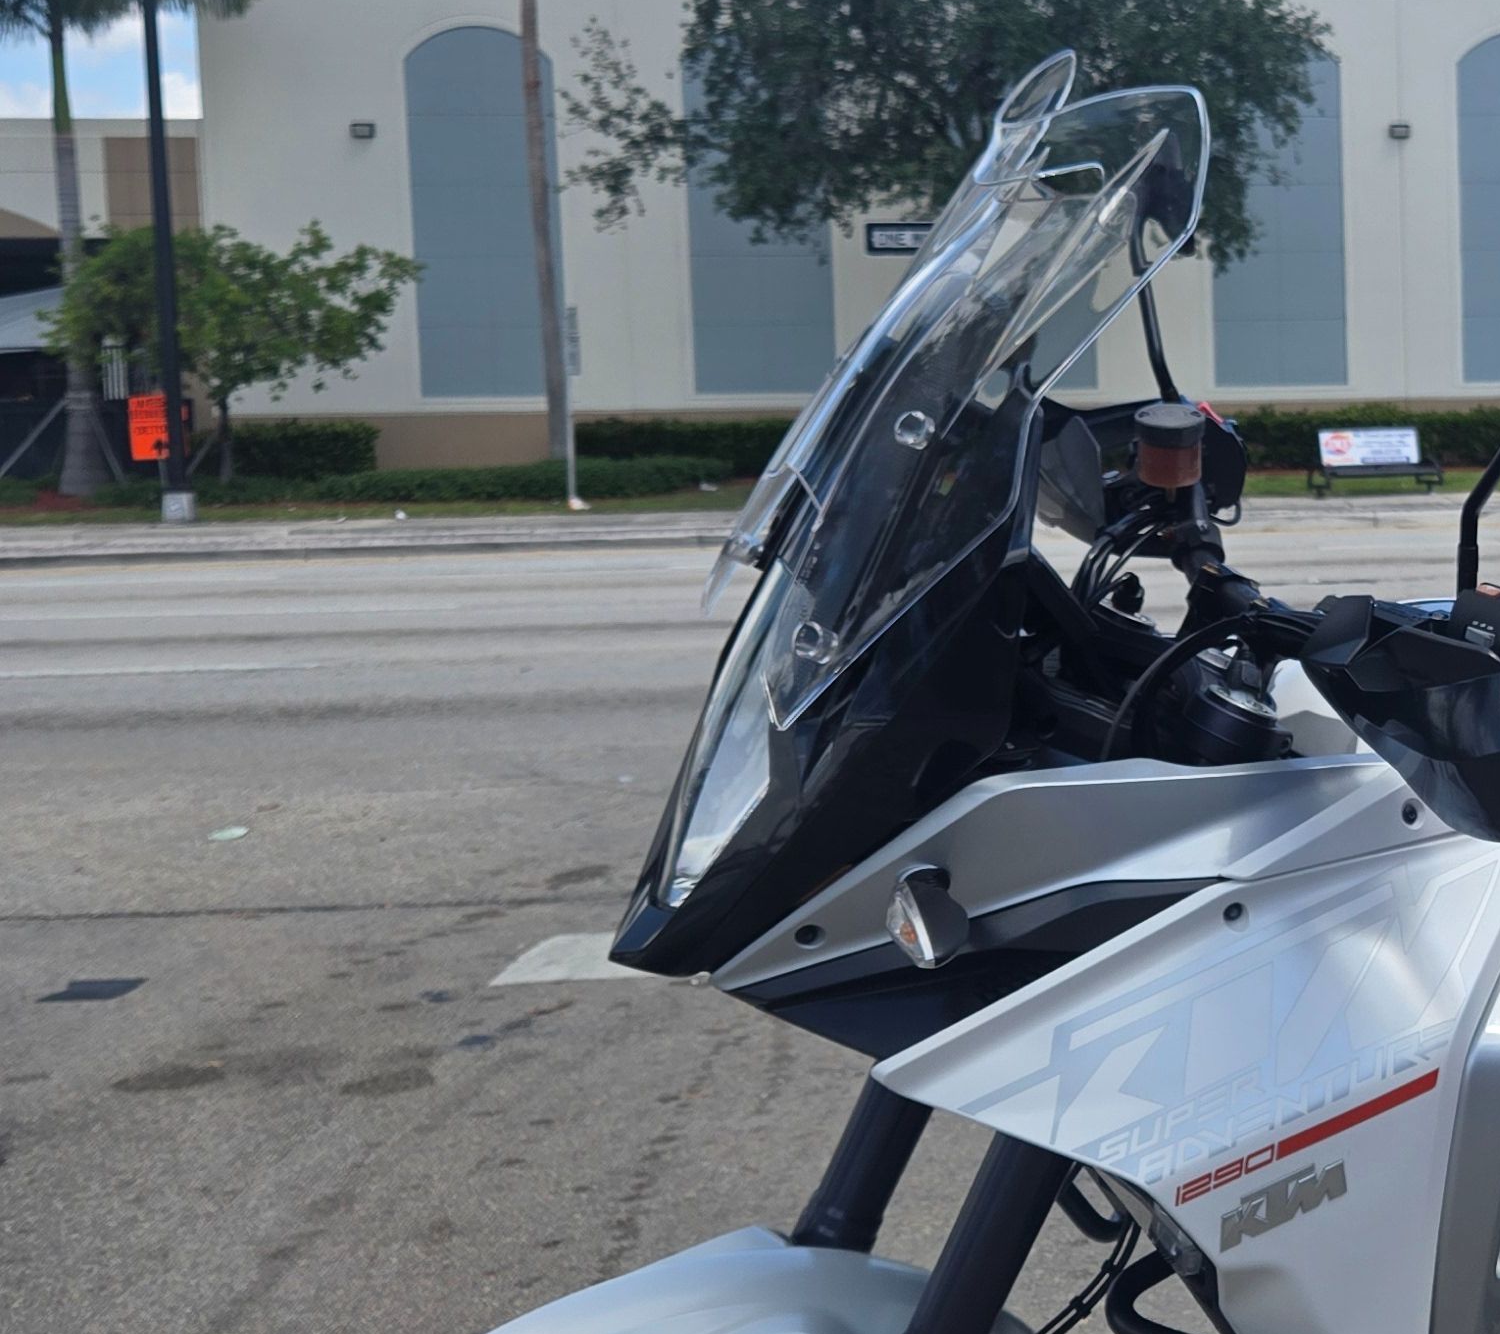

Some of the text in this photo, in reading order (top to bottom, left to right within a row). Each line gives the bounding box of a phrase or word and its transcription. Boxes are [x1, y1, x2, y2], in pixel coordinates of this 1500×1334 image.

[1099, 1060, 1268, 1165] SUPER
[1174, 1143, 1276, 1207] 1290
[1219, 1158, 1348, 1254] KTM
